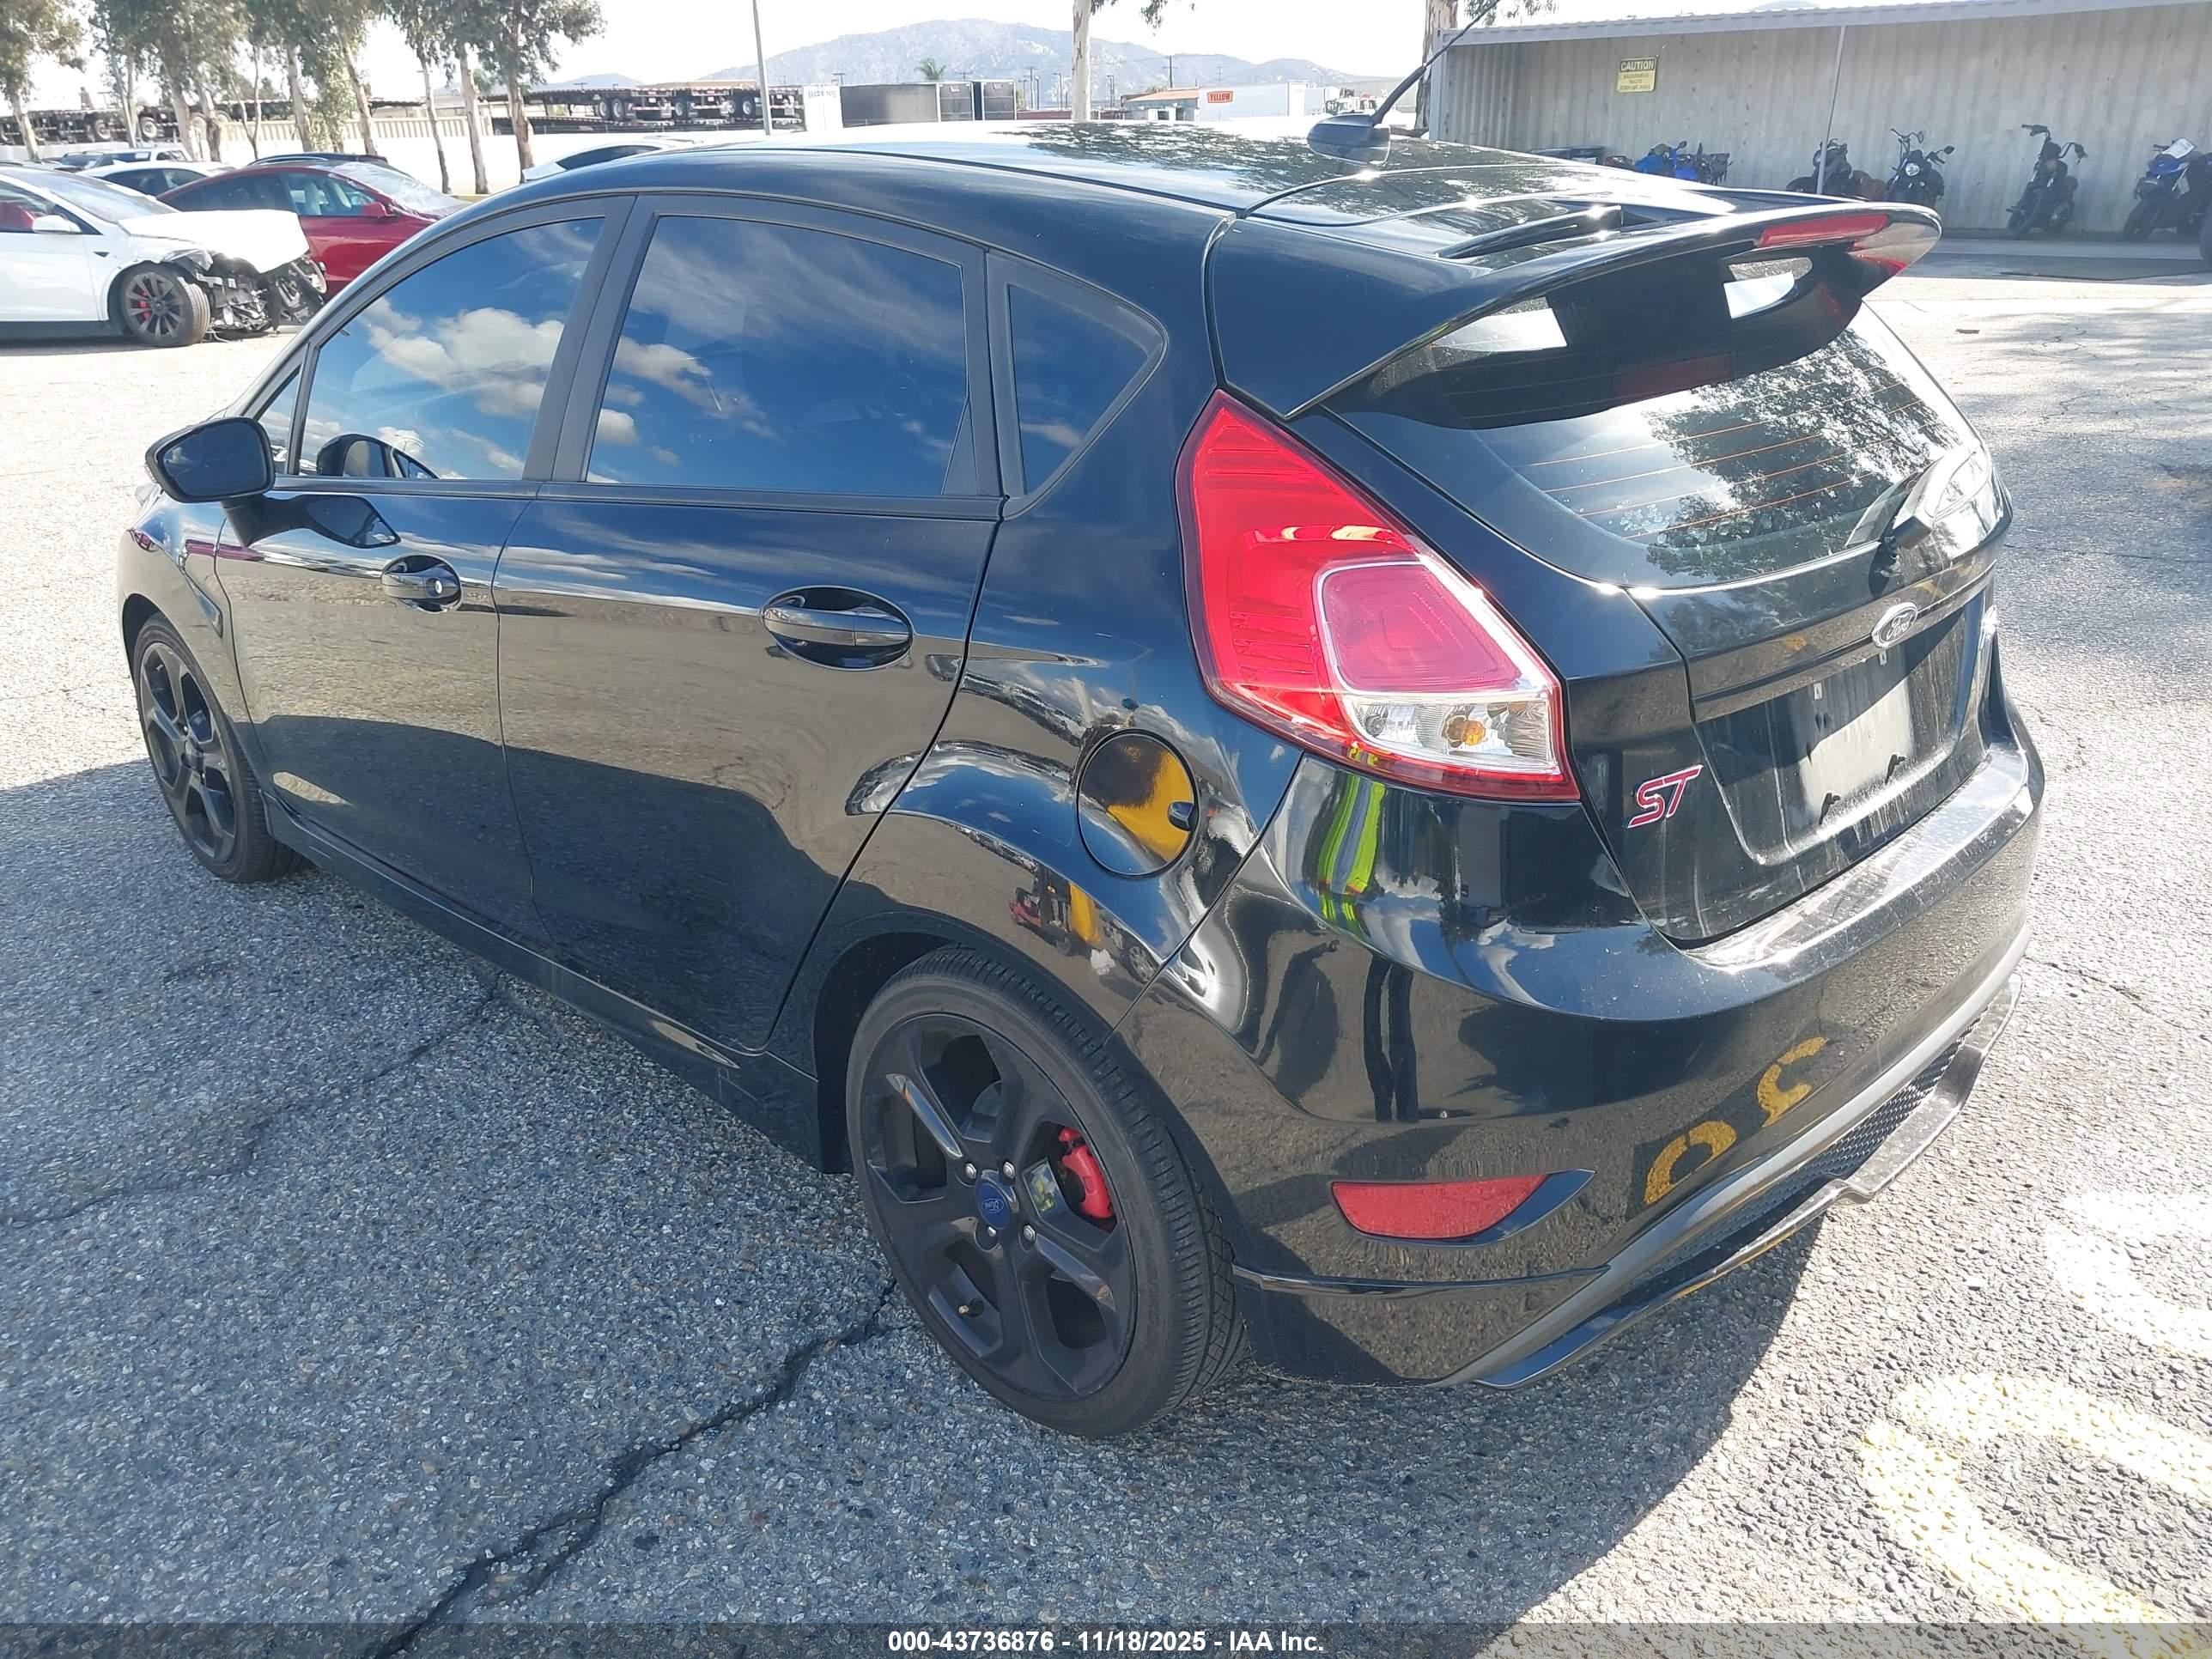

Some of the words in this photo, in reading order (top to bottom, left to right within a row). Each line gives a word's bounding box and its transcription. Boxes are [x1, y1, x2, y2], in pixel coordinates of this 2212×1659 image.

[1620, 60, 1655, 71] CAUTION
[1210, 93, 1231, 101] YELLOW
[1627, 764, 1705, 829] ST
